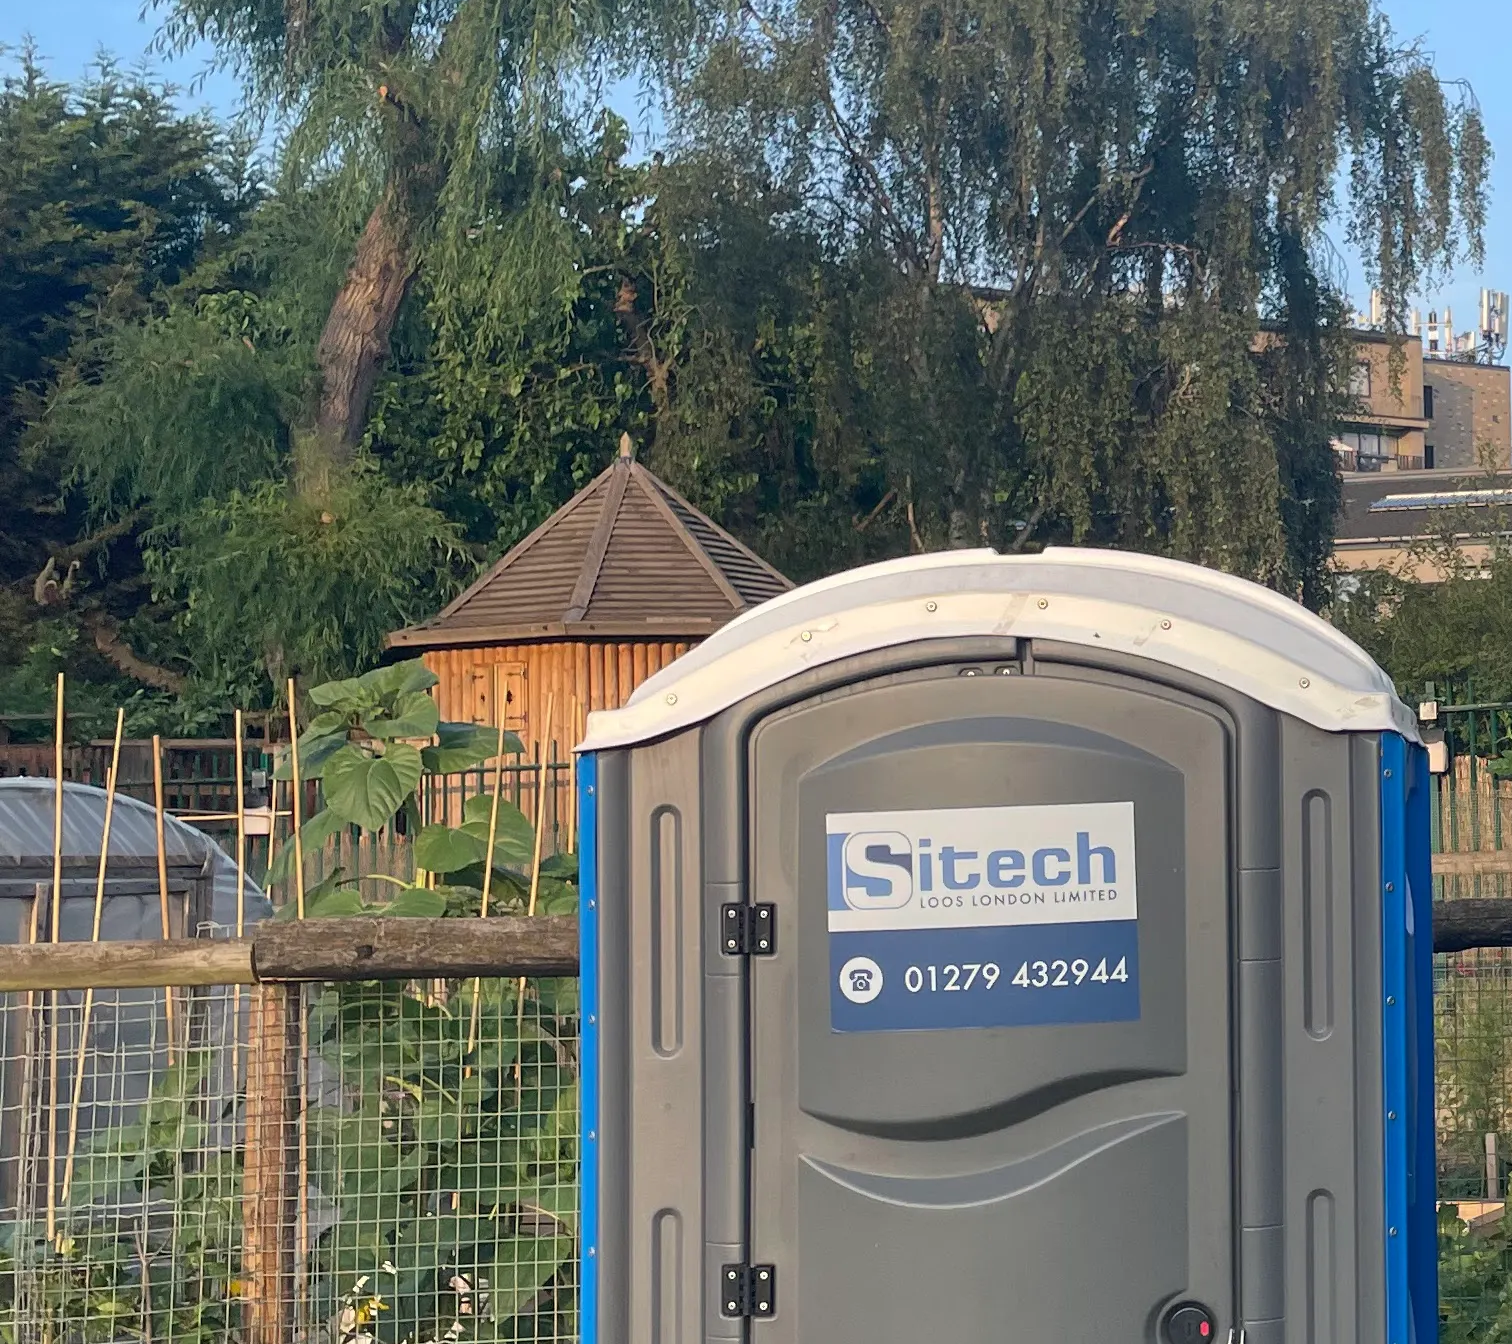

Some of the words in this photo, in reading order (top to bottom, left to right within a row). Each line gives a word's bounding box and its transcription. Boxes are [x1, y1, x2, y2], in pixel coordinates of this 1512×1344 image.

[845, 831, 1117, 910] Sitech
[920, 895, 964, 909] LOOS
[972, 890, 1045, 907] LONDON
[1054, 888, 1118, 903] LIMITED
[904, 962, 1000, 993] 01279
[1011, 956, 1129, 988] 432944
